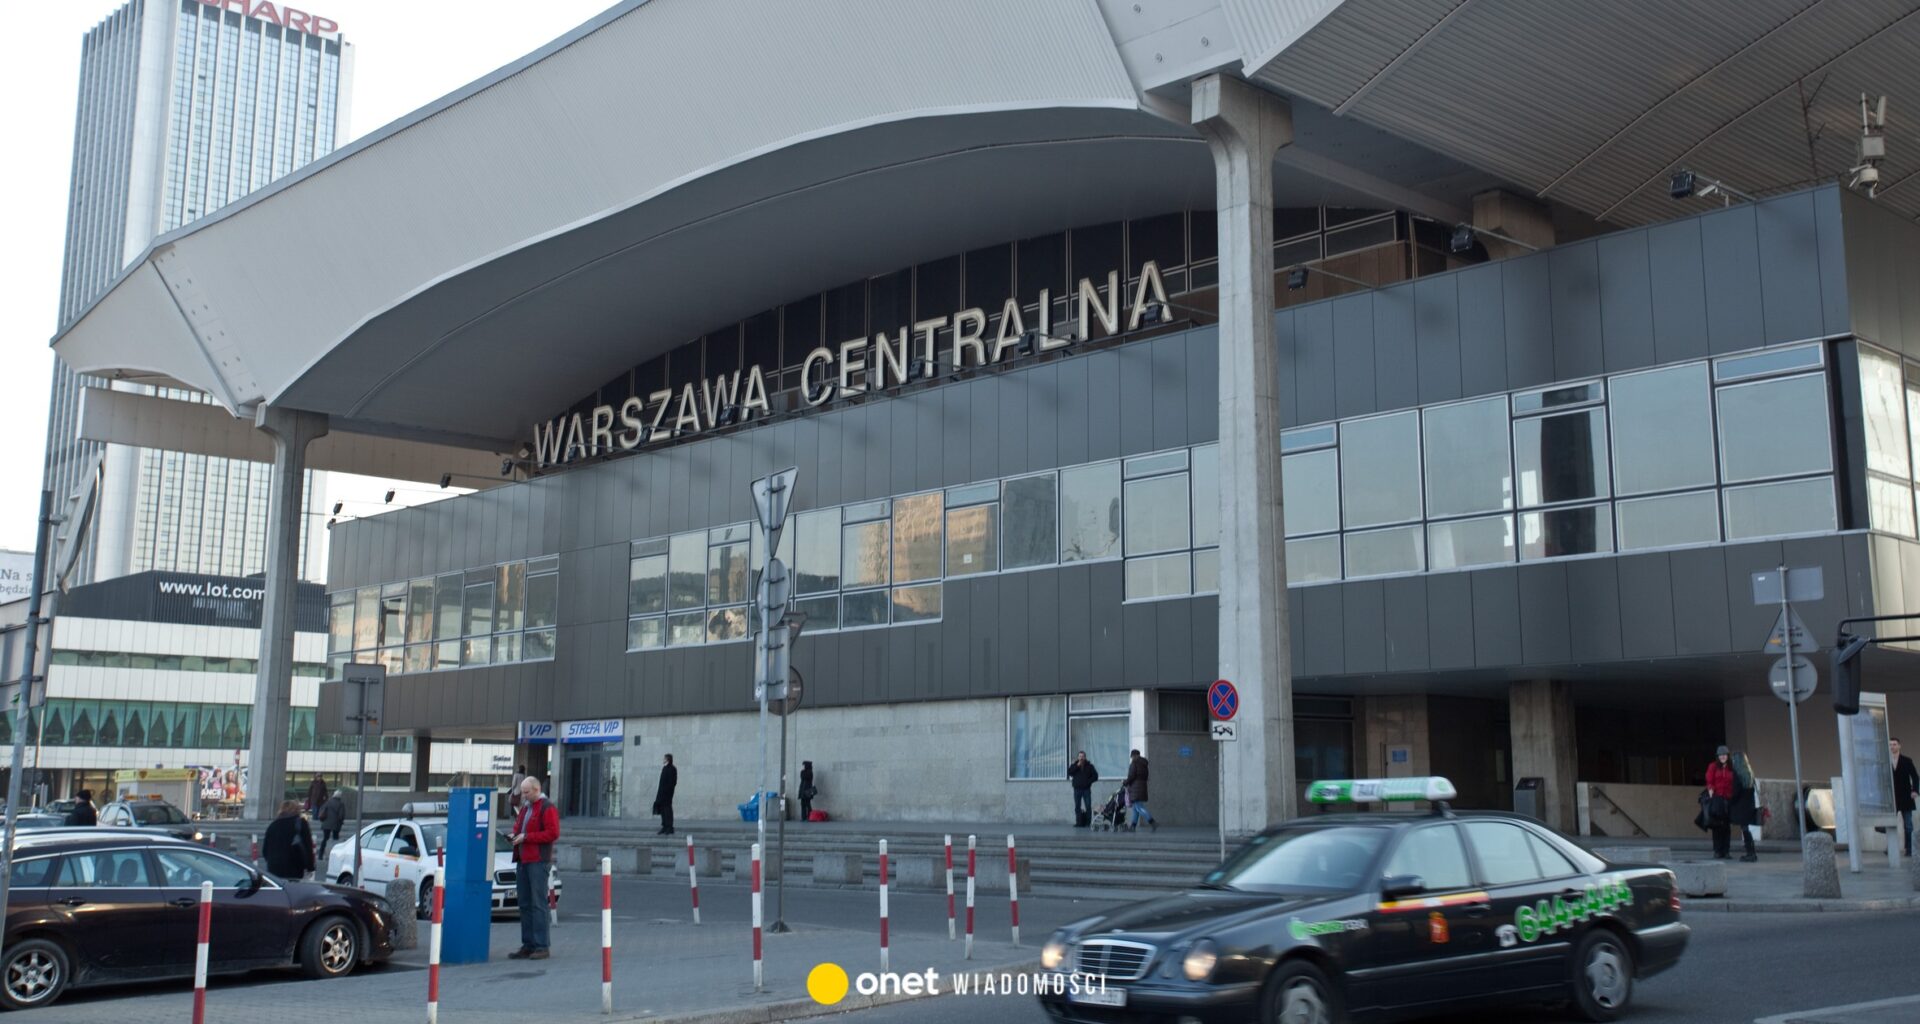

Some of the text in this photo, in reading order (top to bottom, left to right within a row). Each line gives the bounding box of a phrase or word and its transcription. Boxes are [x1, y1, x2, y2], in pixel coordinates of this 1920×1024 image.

[533, 260, 1173, 468] WARSZAWA CENTRALNA
[529, 724, 552, 736] VIP
[569, 721, 619, 735] STREFA VIP
[474, 794, 486, 810] P
